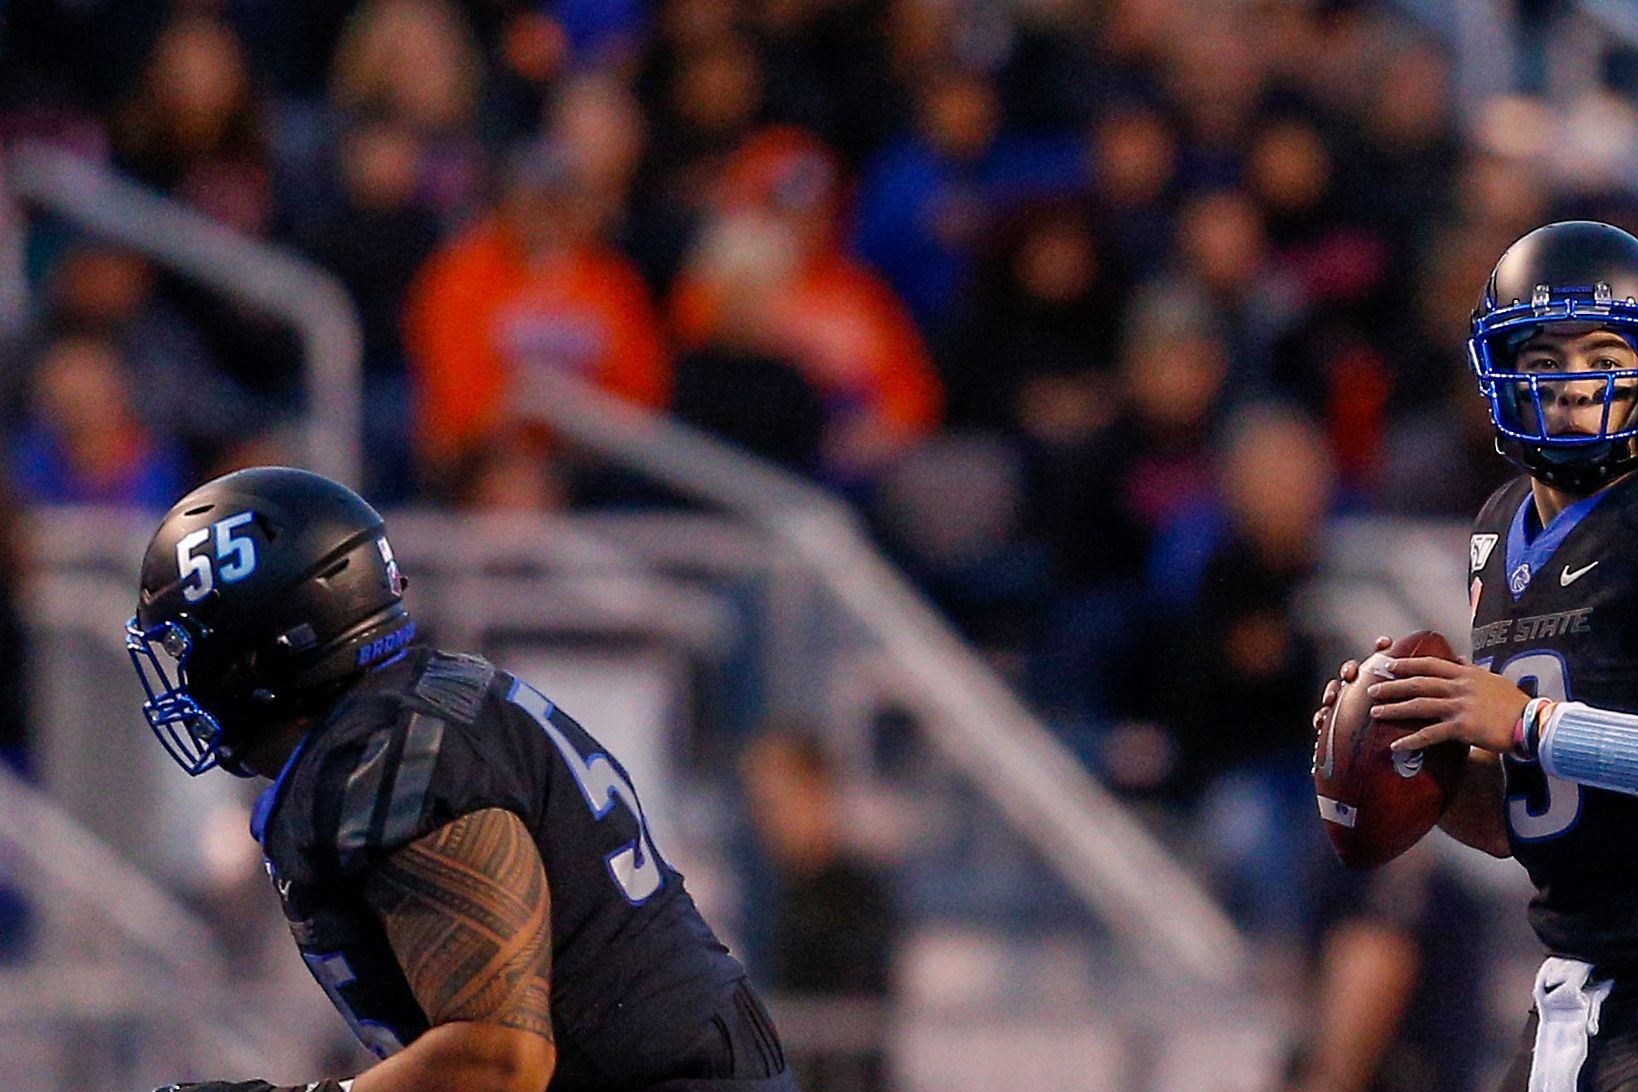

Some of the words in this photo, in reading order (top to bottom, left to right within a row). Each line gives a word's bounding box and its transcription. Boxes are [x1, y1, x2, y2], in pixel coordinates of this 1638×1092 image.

[176, 510, 257, 604] 55
[1471, 619, 1513, 651] OISE
[1513, 607, 1594, 642] STATE
